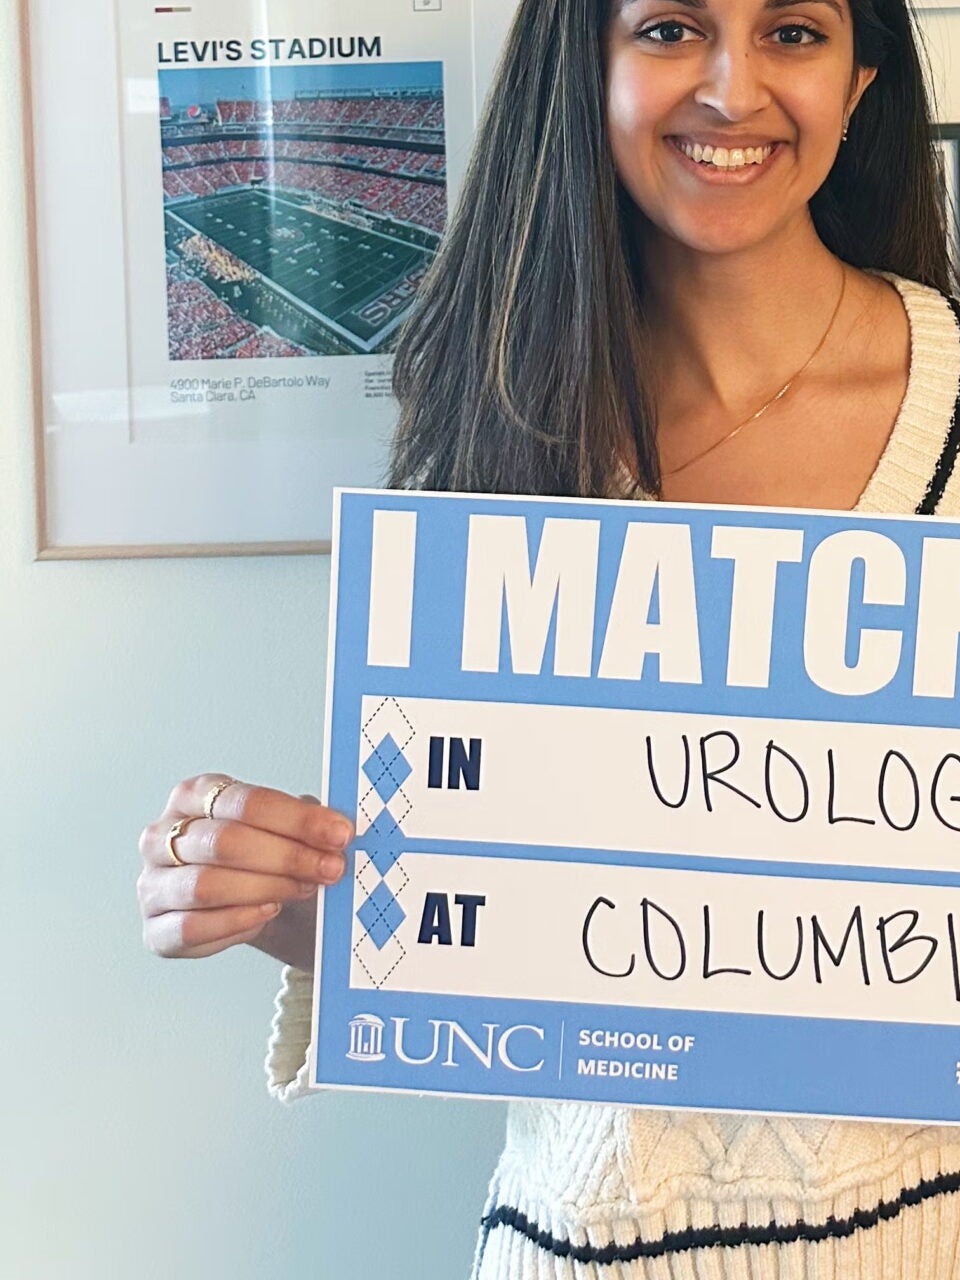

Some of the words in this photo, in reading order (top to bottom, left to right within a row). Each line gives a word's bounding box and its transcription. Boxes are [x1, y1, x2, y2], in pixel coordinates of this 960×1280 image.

[157, 39, 243, 63] LEVI'S
[250, 35, 382, 60] STADIUM
[169, 378, 201, 391] 4900
[202, 377, 232, 389] Marie
[248, 375, 304, 388] DeBartolo
[306, 374, 332, 388] Way
[169, 391, 203, 403] Santa
[205, 390, 238, 402] Clara,
[240, 389, 256, 401] CA
[366, 509, 417, 669] I
[427, 735, 482, 791] IN
[417, 891, 486, 948] AT
[390, 1016, 545, 1072] UNC
[578, 1028, 663, 1051] SCHOOL
[668, 1034, 696, 1052] OF
[576, 1058, 679, 1081] MEDICINE
